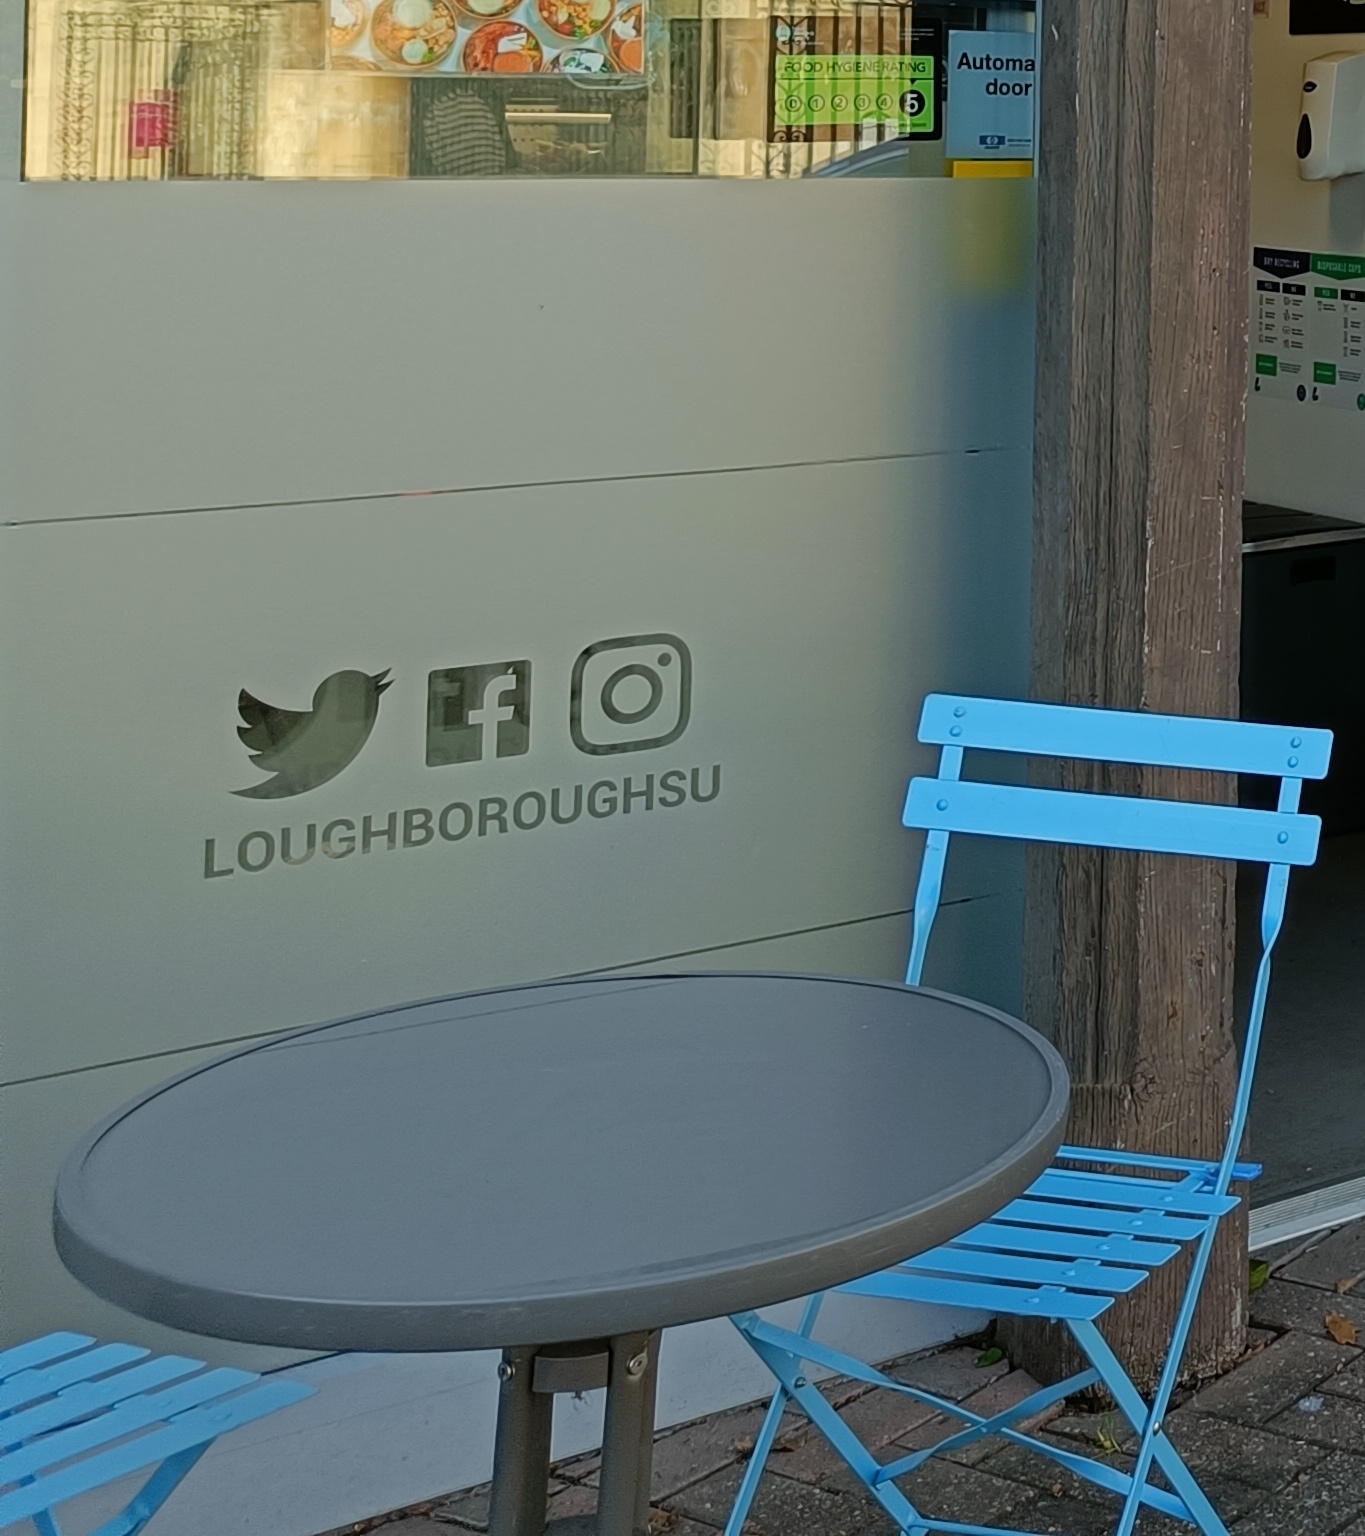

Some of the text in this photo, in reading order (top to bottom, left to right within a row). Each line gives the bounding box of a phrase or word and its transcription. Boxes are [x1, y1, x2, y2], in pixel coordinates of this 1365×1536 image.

[785, 61, 926, 74] FOOD HYGIENE RATING
[957, 52, 1035, 72] Automa
[985, 78, 1032, 97] door
[905, 93, 918, 112] 5
[204, 765, 721, 880] LOUGHBOROUGHSU
